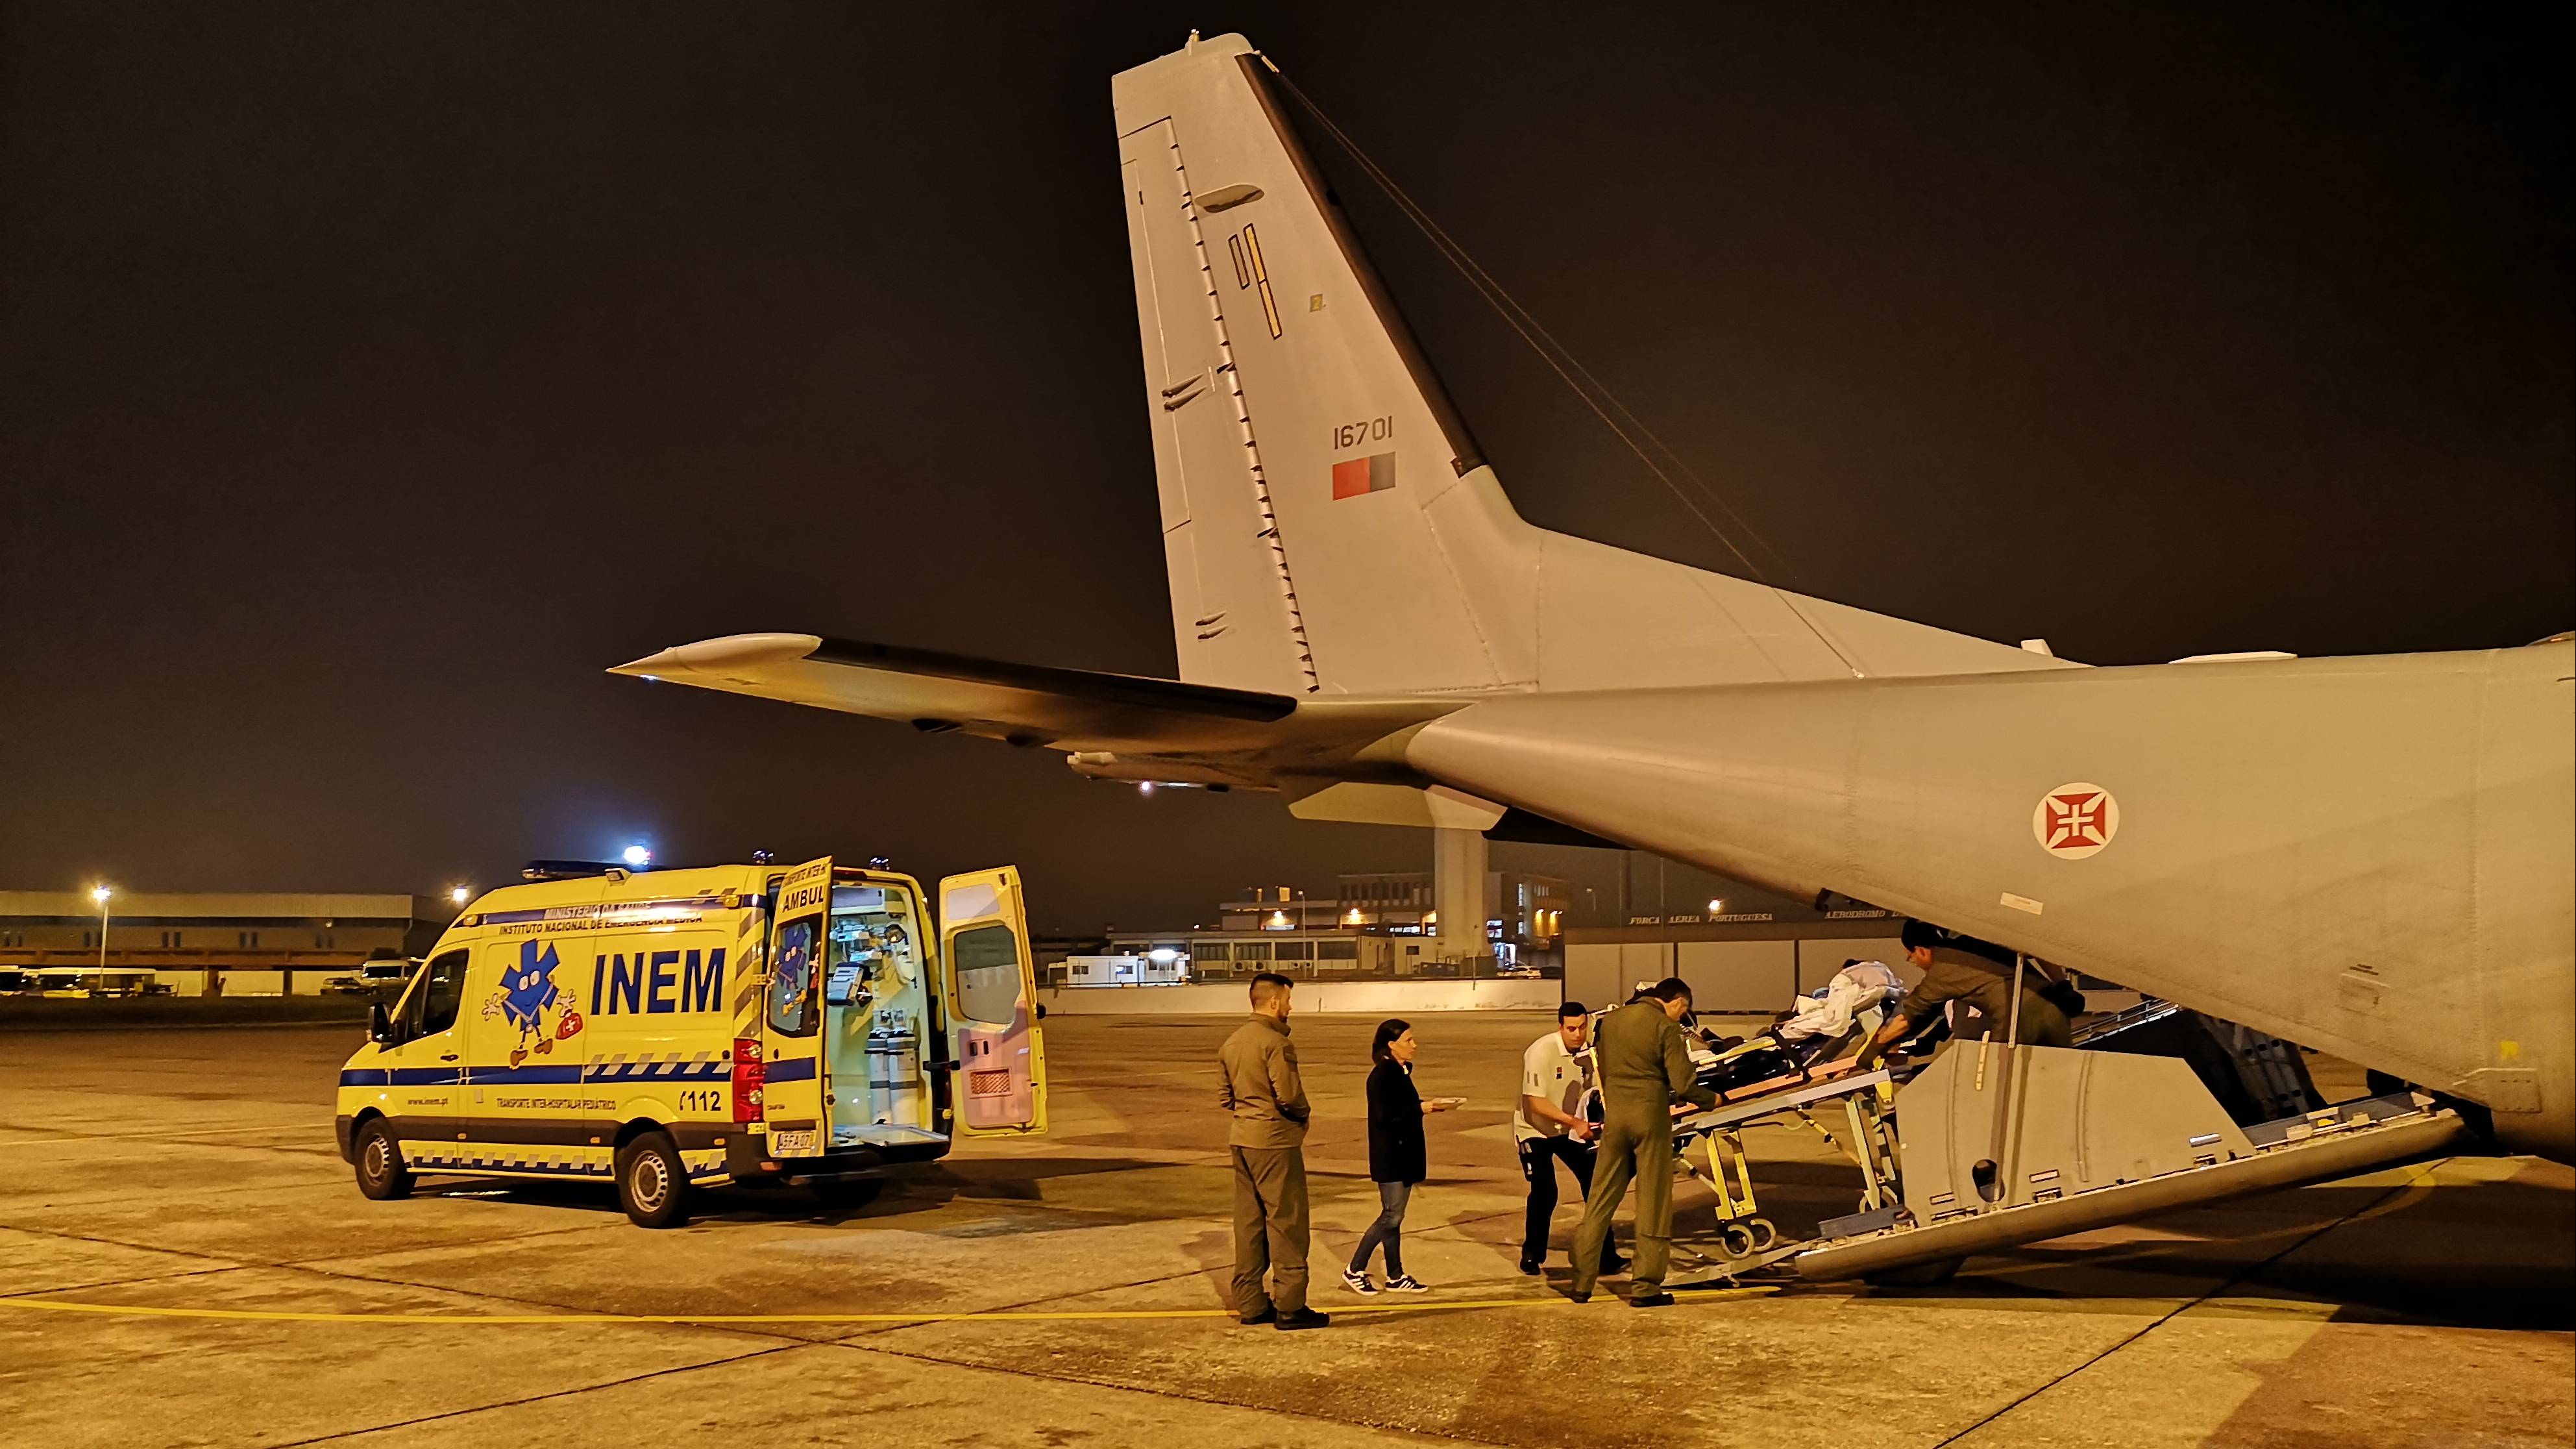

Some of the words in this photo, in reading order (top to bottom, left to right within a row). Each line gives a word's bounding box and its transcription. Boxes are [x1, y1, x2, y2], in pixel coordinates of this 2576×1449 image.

[1334, 415, 1392, 450] 16701
[782, 885, 824, 913] AMBUL
[499, 923, 543, 935] INSTITUTO
[545, 919, 587, 932] NACIONAL
[590, 919, 602, 930] DE
[1630, 916, 1660, 925] FORÇA
[1708, 913, 1773, 923] PORTUGUESA
[590, 947, 726, 1015] INEM
[497, 1097, 530, 1109] TRANSPORTE
[688, 1090, 721, 1111] 112
